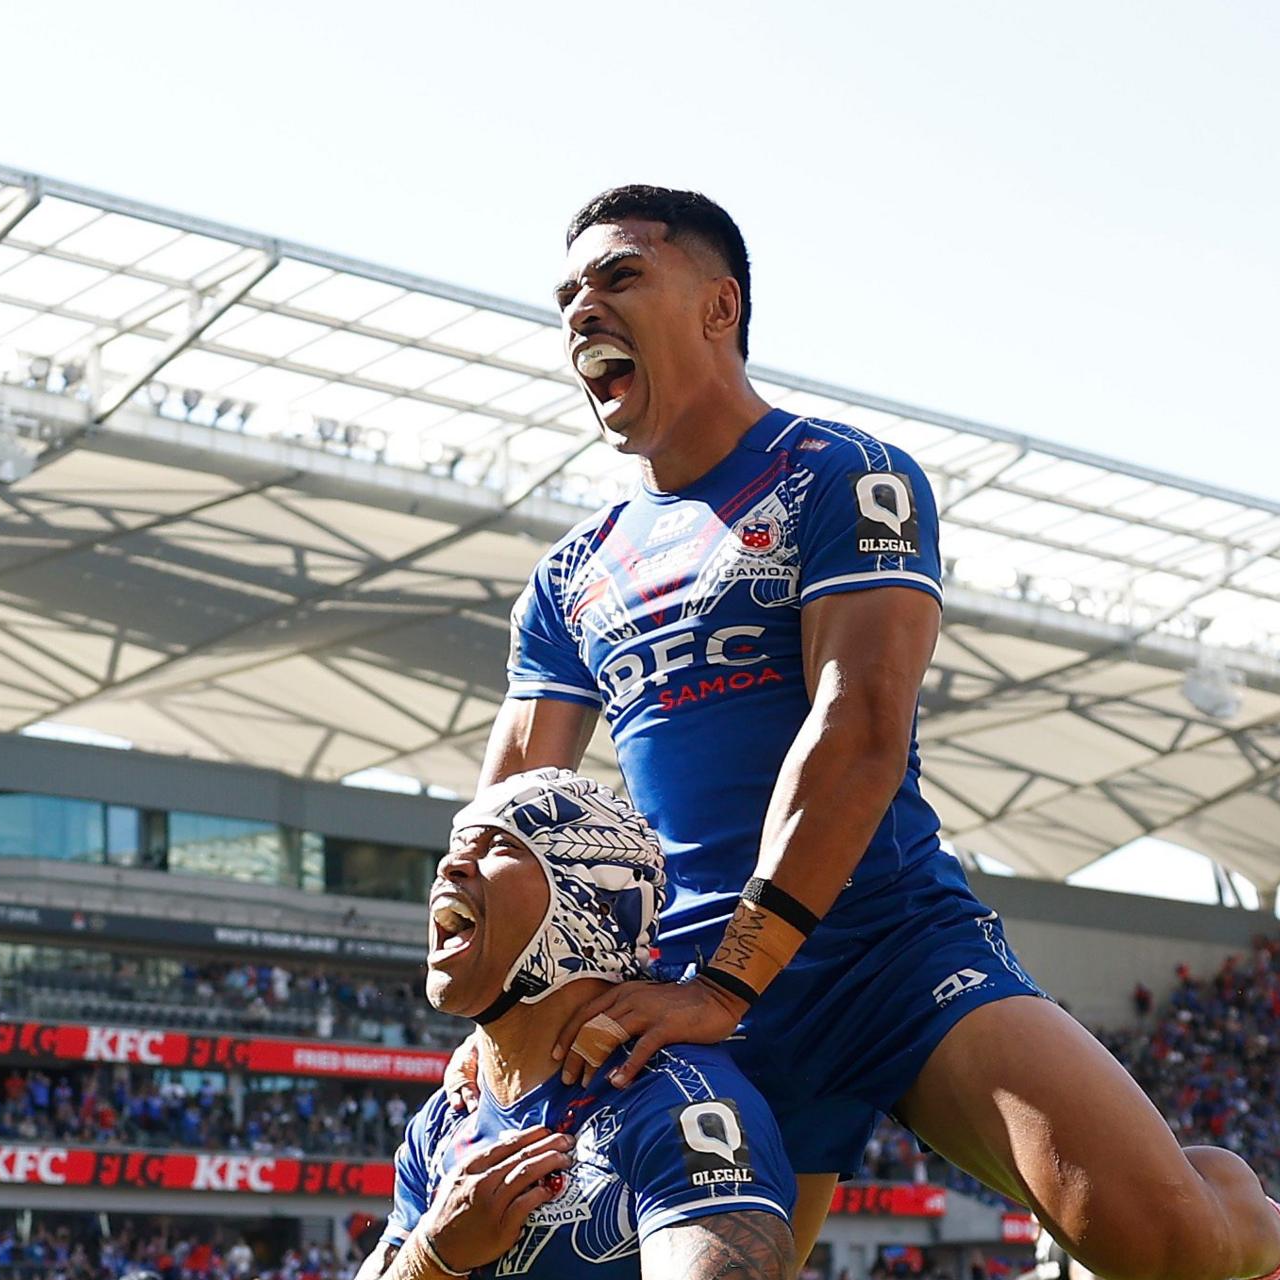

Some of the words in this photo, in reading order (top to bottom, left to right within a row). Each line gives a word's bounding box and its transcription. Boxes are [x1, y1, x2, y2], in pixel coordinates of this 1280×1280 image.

[859, 539, 916, 553] QLEGAL
[724, 567, 794, 578] SAMOA
[658, 667, 783, 711] SAMOA
[725, 910, 767, 970] MUM
[83, 1025, 164, 1065] KFC
[293, 1048, 342, 1071] FRIED
[345, 1051, 392, 1075] NIGHT
[191, 1154, 276, 1192] KFC
[692, 1168, 752, 1186] QLEGAL
[528, 1208, 586, 1223] SAMOA
